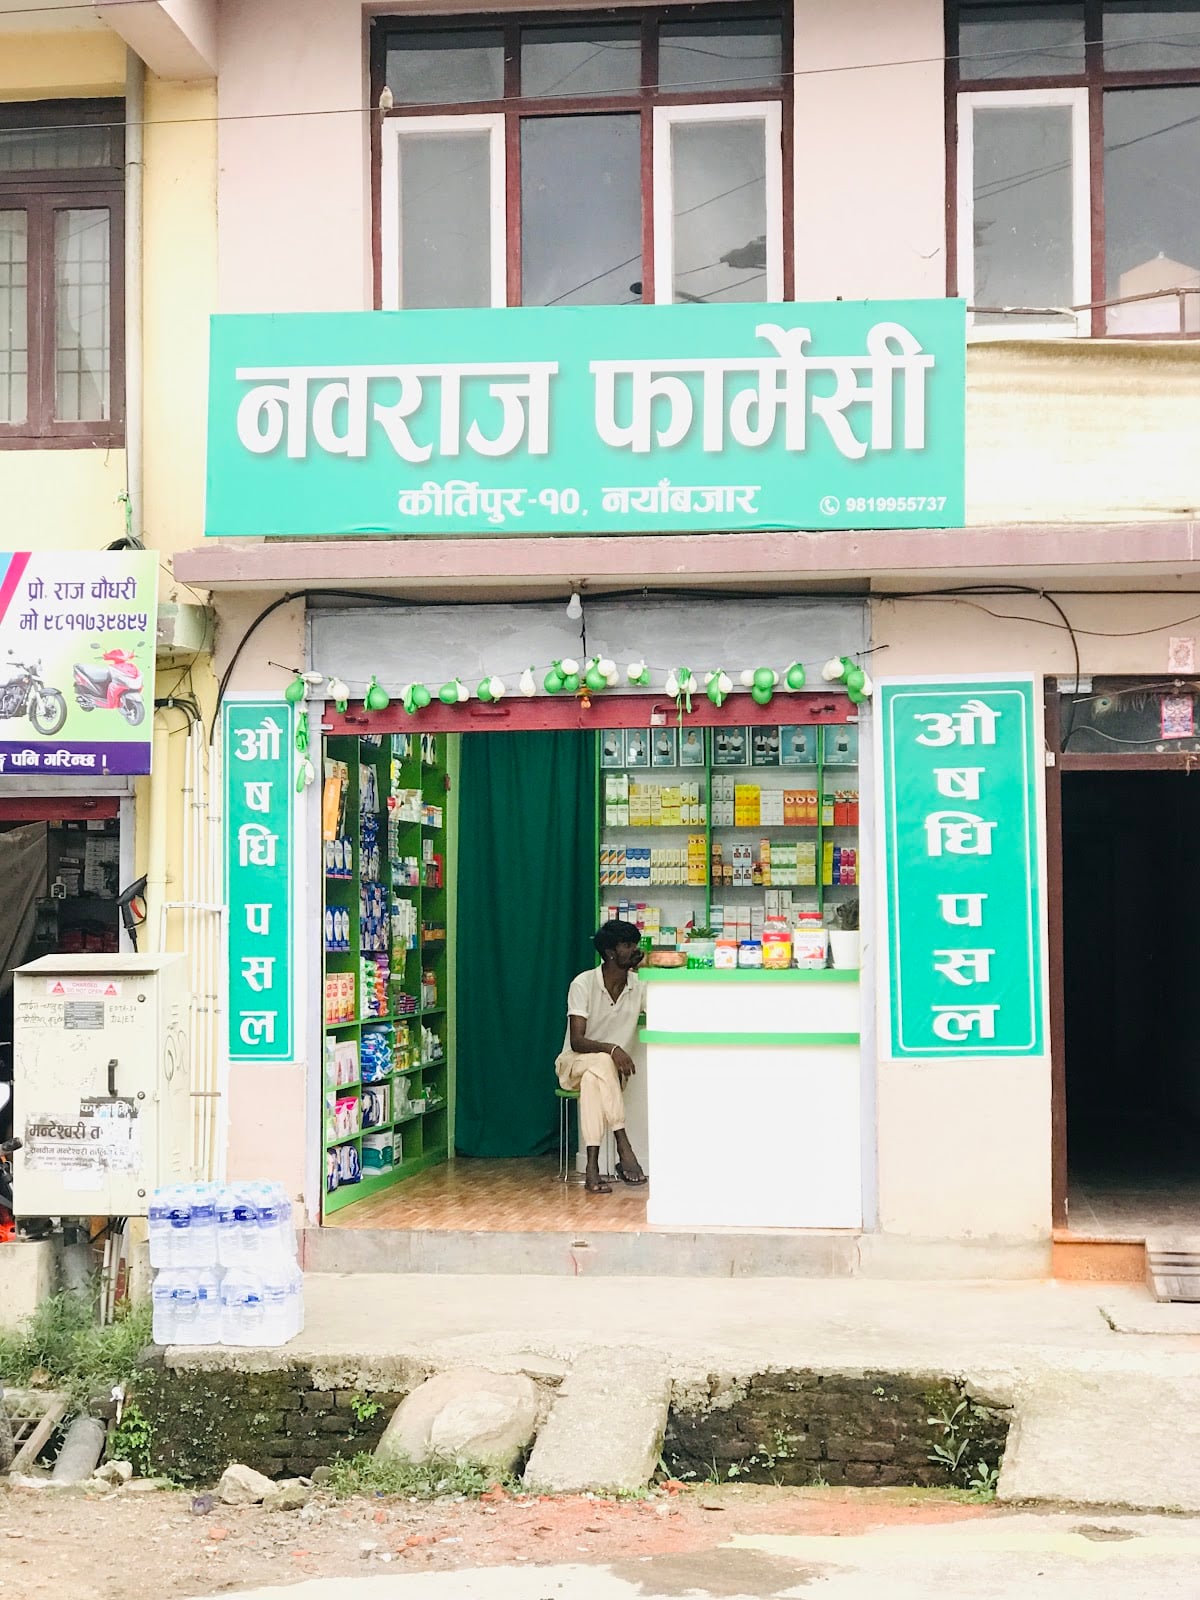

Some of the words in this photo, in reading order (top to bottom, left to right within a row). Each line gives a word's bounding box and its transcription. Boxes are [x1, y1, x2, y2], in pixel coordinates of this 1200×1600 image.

[236, 361, 559, 463] नवराज
[589, 322, 935, 459] फार्मेसी
[601, 477, 761, 514] नयाँबजार
[845, 497, 948, 512] 9819955737
[54, 581, 85, 601] राज
[91, 576, 137, 601] चौधरी
[19, 608, 39, 631] मो
[11, 749, 40, 767] पनि
[44, 749, 97, 768] गरिन्छ
